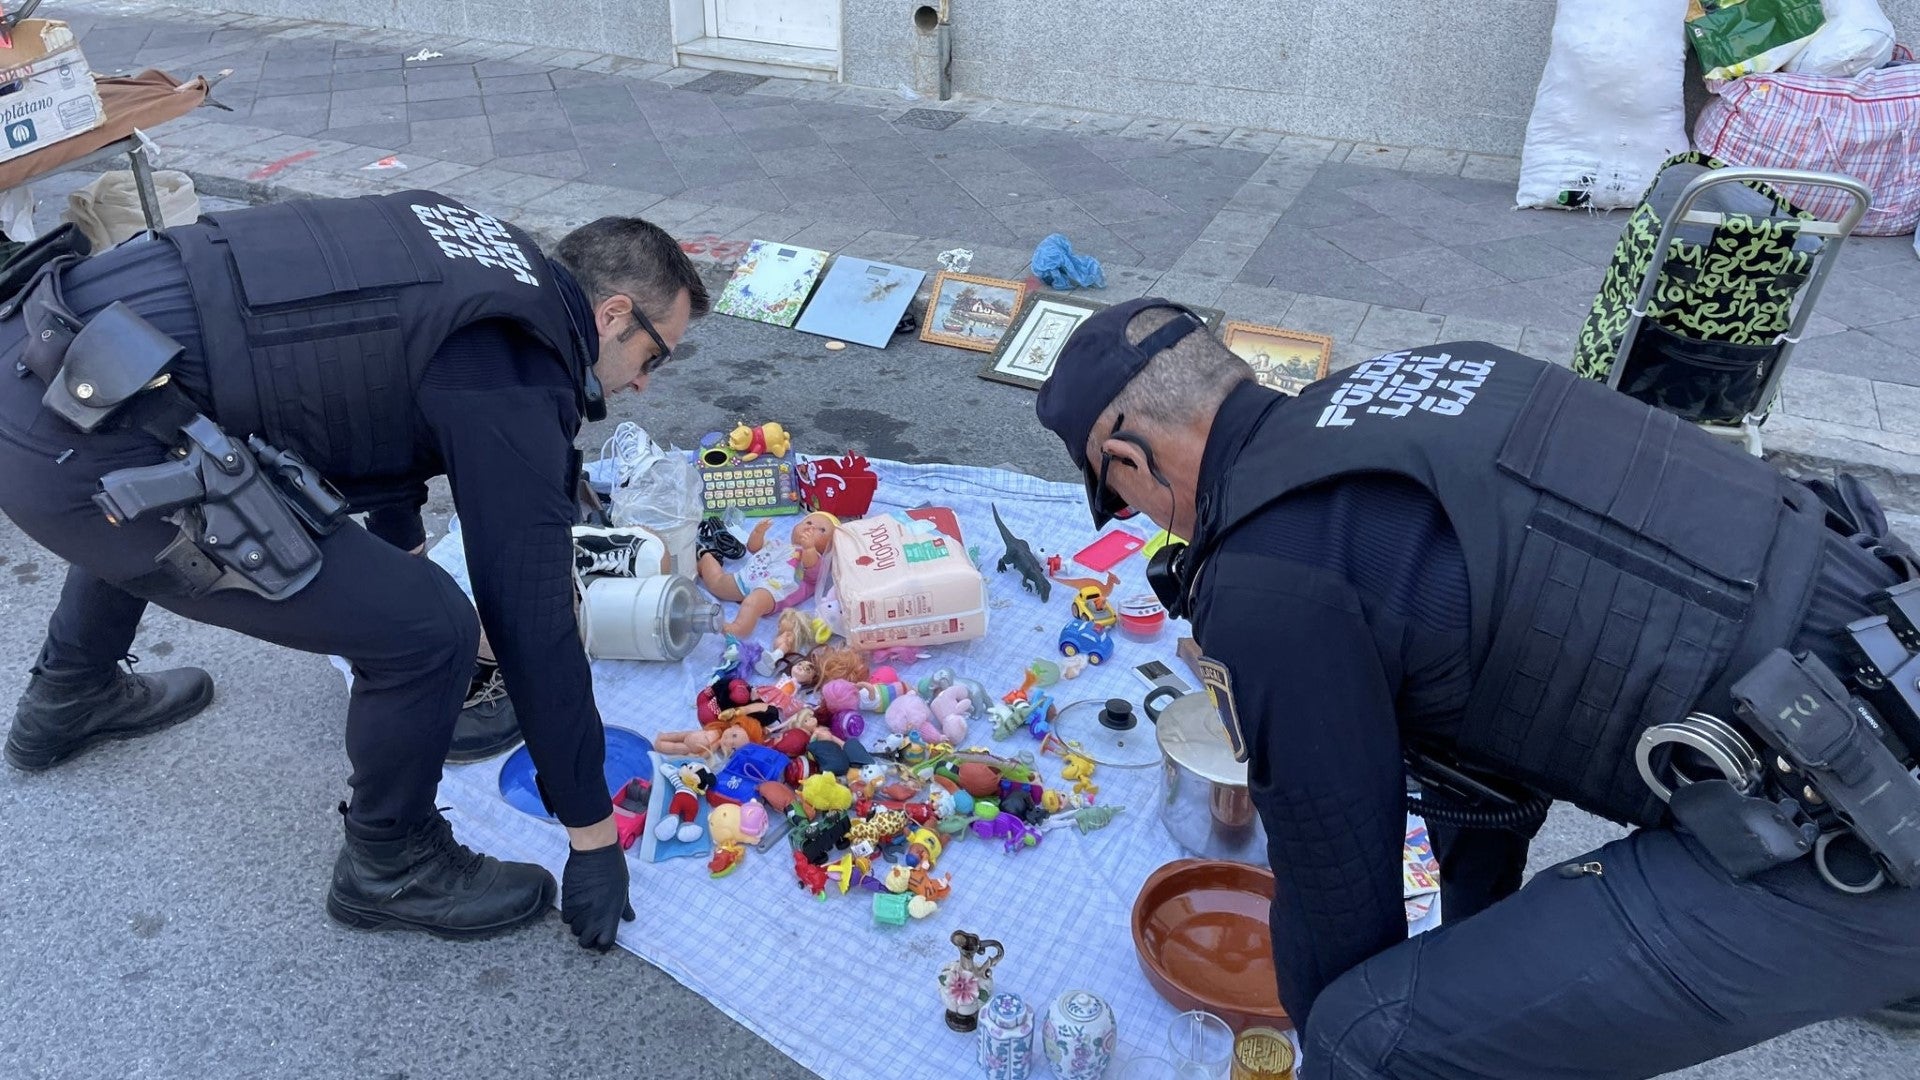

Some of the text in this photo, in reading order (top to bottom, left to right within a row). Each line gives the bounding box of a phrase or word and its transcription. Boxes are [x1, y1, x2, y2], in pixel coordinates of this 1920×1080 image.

[437, 203, 508, 270] LOCAL
[463, 205, 540, 287] OLICIA
[1315, 350, 1412, 427] POLICIA
[1366, 352, 1452, 418] LOCAL
